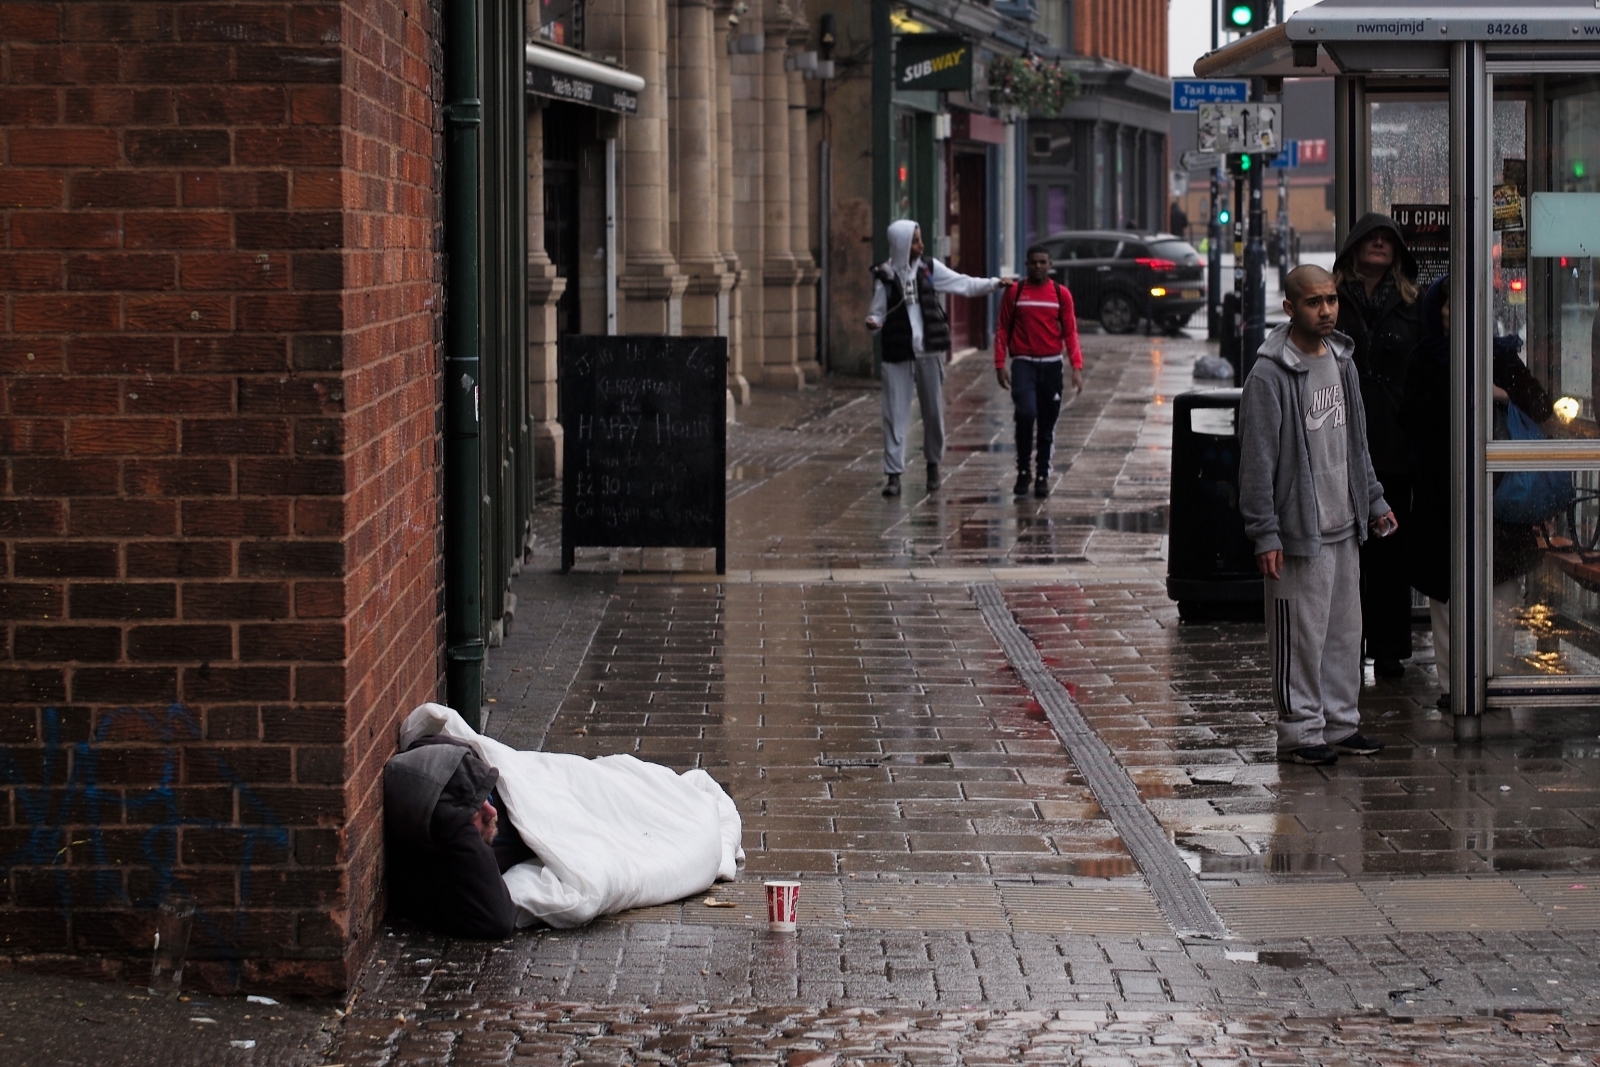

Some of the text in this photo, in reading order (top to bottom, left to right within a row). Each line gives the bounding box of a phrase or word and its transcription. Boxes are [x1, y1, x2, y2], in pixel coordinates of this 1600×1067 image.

[1356, 20, 1425, 36] nwmajmjd
[1487, 23, 1528, 35] 84268
[902, 47, 967, 83] SUBWAY
[1183, 84, 1238, 95] Taxi Rank
[1312, 384, 1340, 413] NIKE
[655, 413, 710, 446] HOUR
